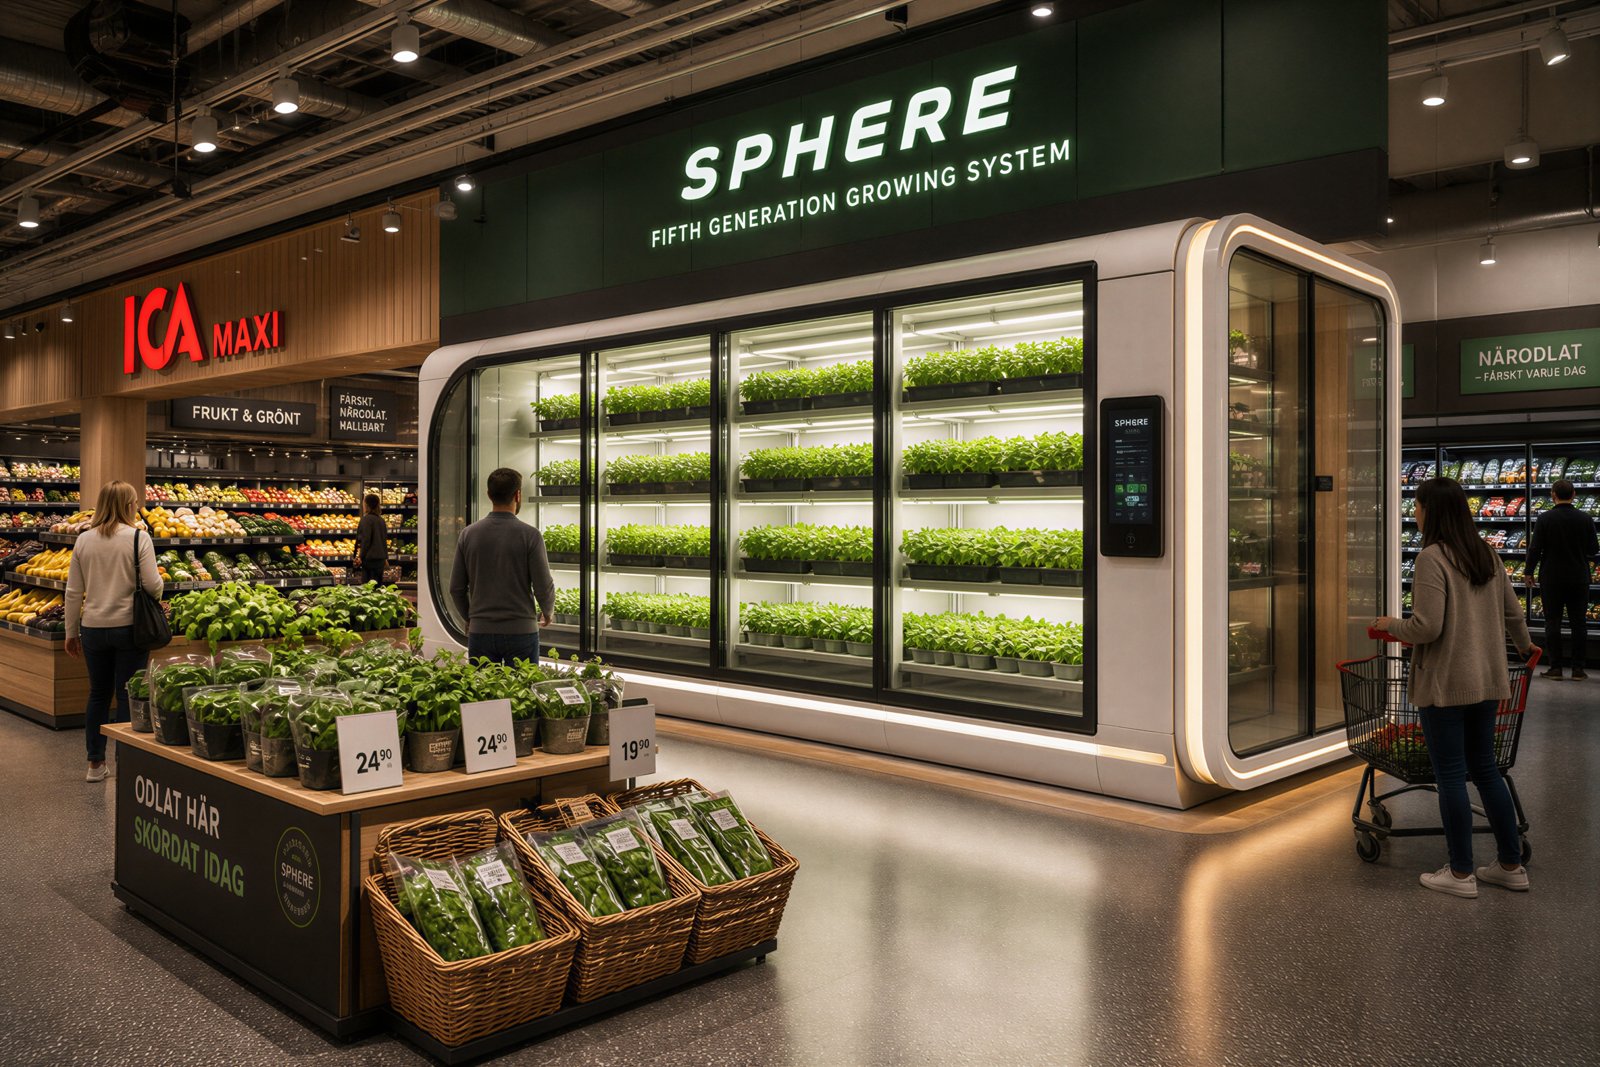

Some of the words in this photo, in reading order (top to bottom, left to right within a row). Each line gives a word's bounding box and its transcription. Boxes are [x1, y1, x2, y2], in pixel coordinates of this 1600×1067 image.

[680, 64, 1019, 202] SPHERE
[650, 222, 701, 249] FIFTH
[709, 191, 836, 236] GENERATION
[845, 166, 957, 208] GROWING
[967, 139, 1071, 183] SYSTEM
[123, 281, 208, 375] ICA
[213, 309, 284, 359] MAXI
[1479, 343, 1582, 367] NÄRODLAT
[192, 405, 238, 421] FRUKT
[242, 408, 253, 423] &
[1114, 418, 1149, 427] SPHERE
[135, 774, 182, 820] ODLAT
[186, 794, 220, 840] HÄR
[134, 815, 200, 874] SKÖRDAT
[204, 848, 245, 898] IDAG
[280, 862, 314, 891] SPHERE
